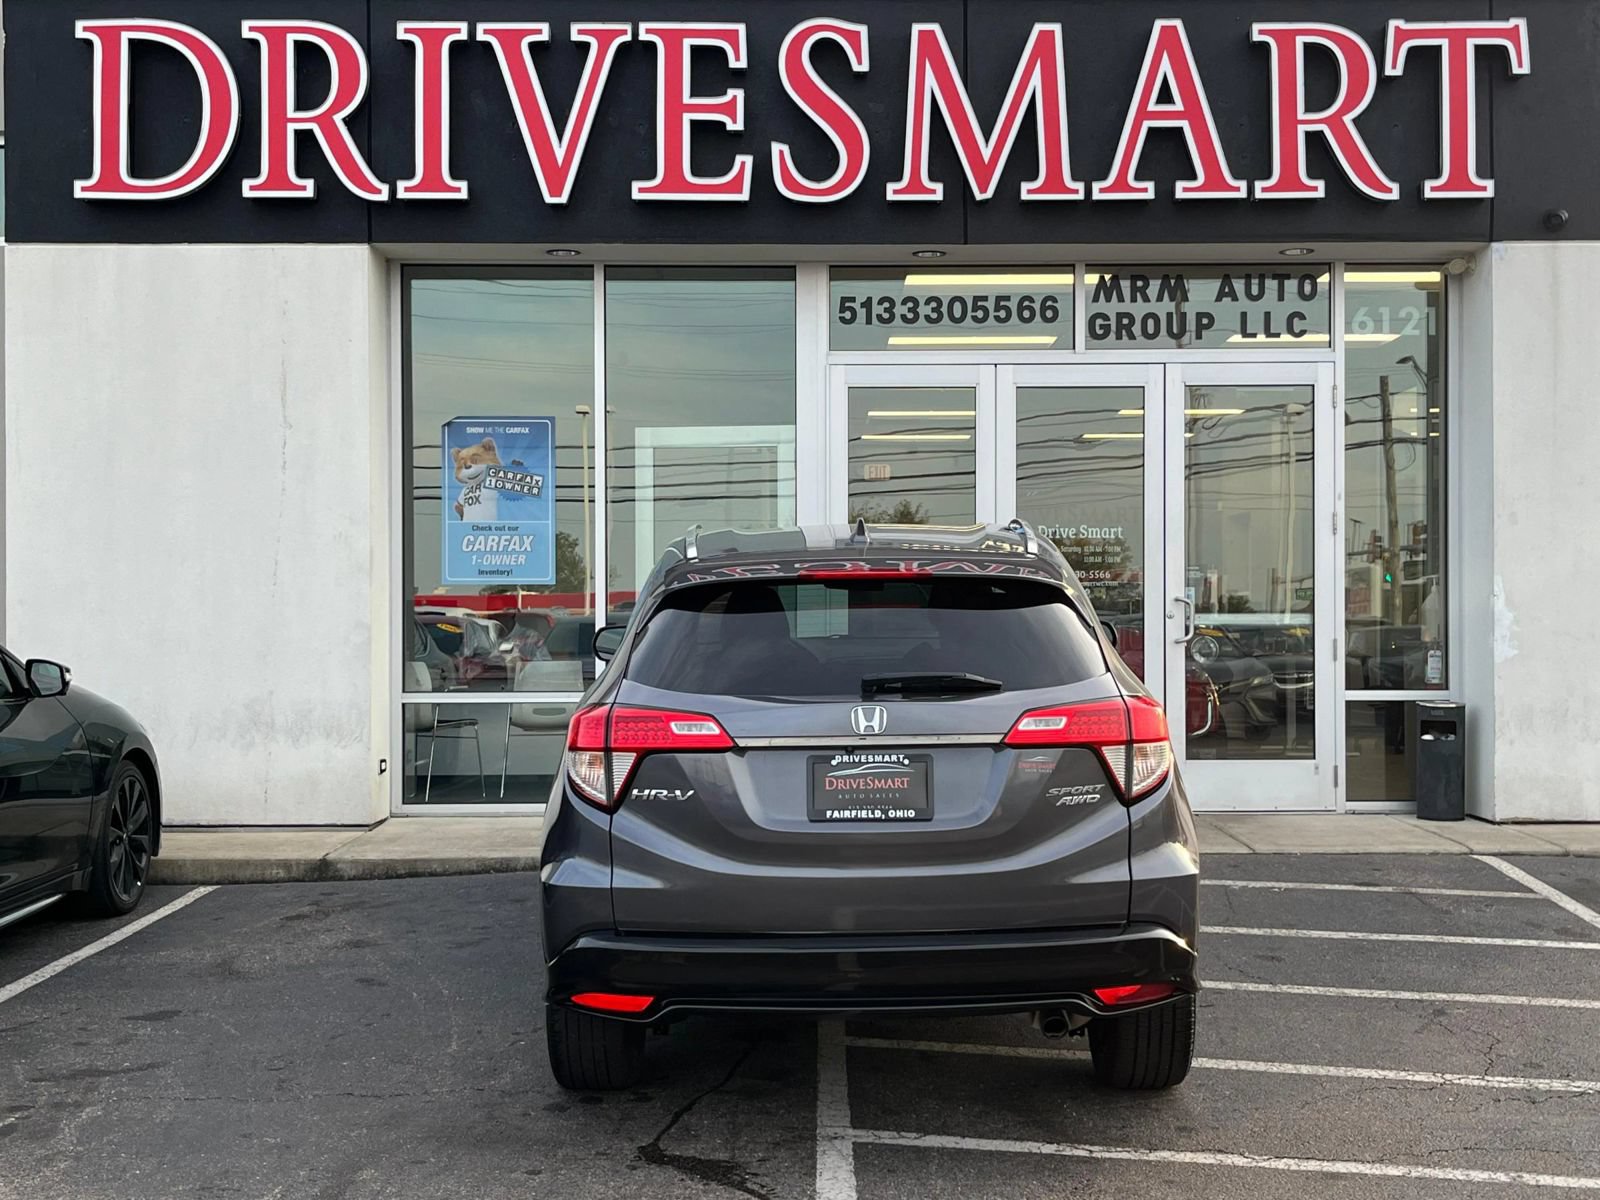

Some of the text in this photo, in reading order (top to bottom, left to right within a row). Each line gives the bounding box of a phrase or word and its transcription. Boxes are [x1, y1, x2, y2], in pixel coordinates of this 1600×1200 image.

[73, 17, 1531, 204] DRIVESMART
[1091, 273, 1318, 304] MRM AUTO
[838, 295, 1060, 326] 5133305566
[1088, 310, 1308, 341] GROUP LLC
[1351, 305, 1436, 336] 6121
[466, 426, 484, 434] SHOW
[505, 426, 530, 434] CARFAX
[488, 468, 543, 486] CARFAX
[464, 484, 482, 497] CAR
[464, 494, 482, 506] FOX
[1038, 524, 1124, 539] Drive Smart
[462, 535, 535, 552] CARFAX
[471, 554, 526, 566] 1-OWNER
[478, 569, 513, 577] Inventory!
[835, 754, 905, 763] DRIVESMART
[630, 788, 695, 801] HR-V
[1045, 784, 1105, 797] SPORT
[1056, 794, 1101, 807] AWD
[826, 809, 916, 819] FAIRFIELD, OHIO
